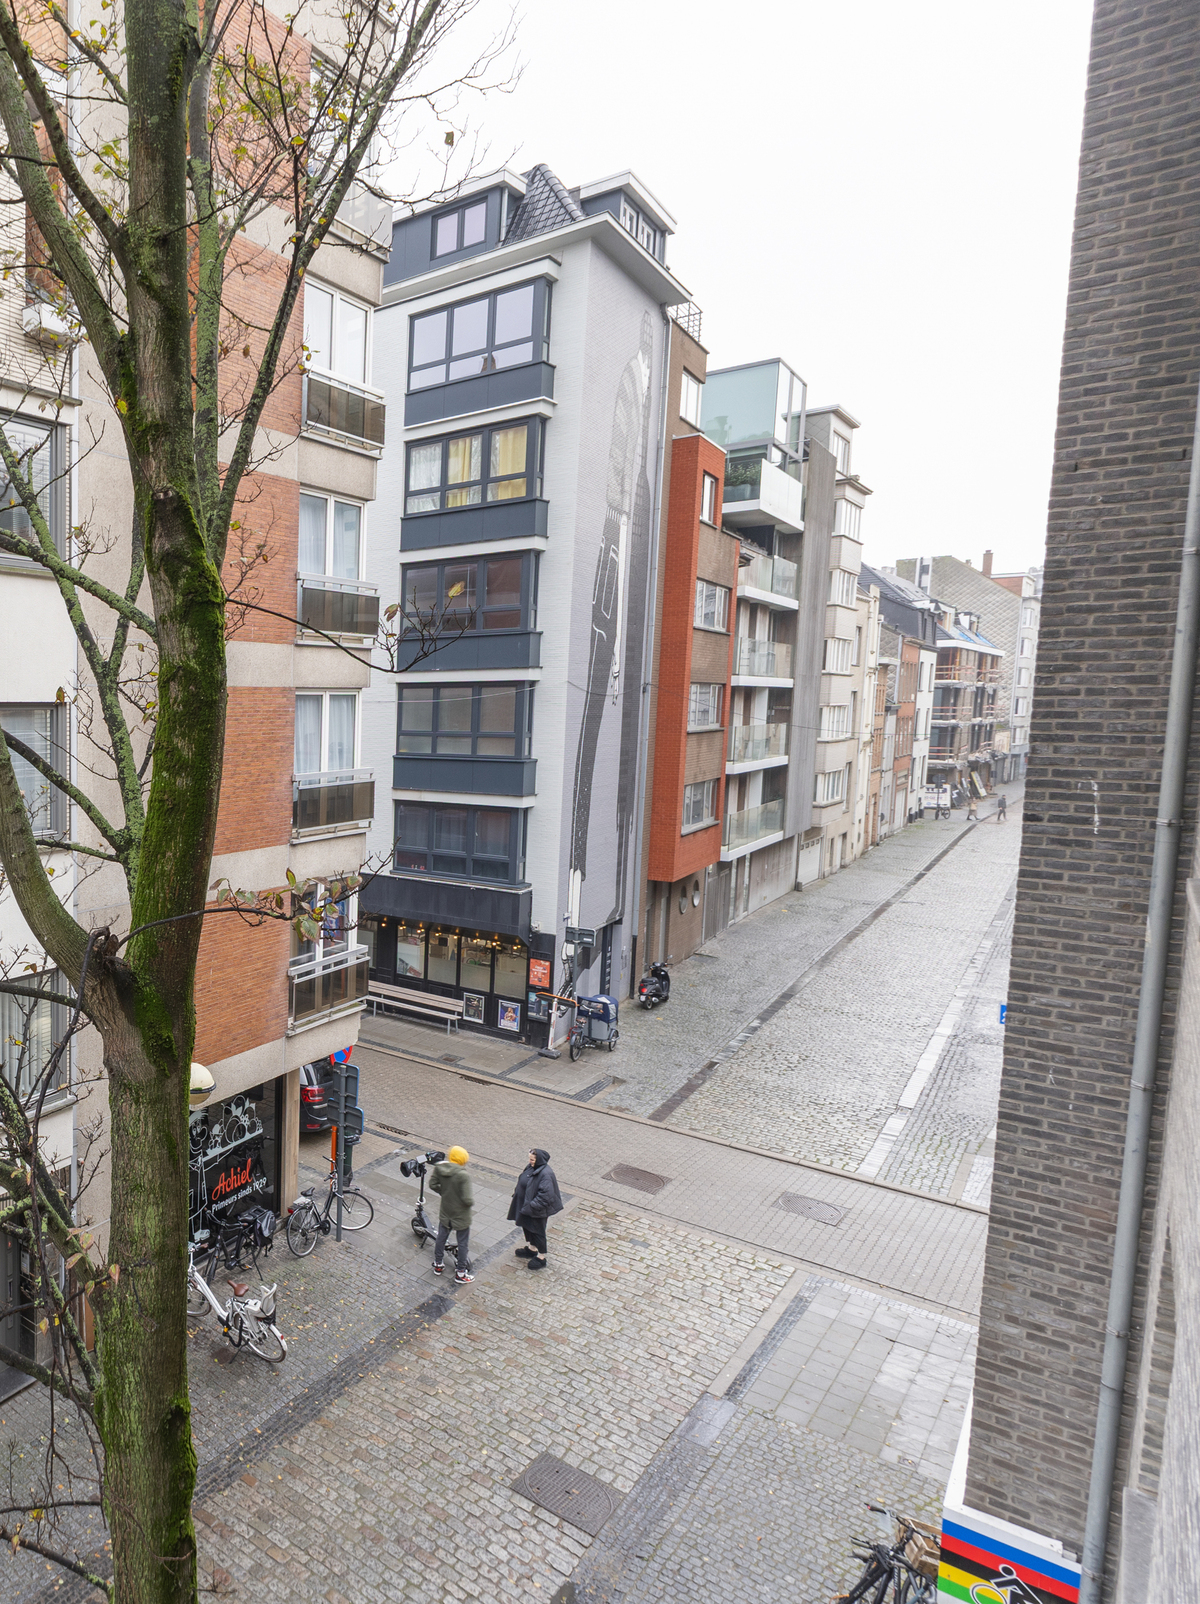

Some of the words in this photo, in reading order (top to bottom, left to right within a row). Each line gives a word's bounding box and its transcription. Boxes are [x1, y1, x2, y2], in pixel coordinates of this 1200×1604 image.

[212, 1158, 252, 1200] Achiel
[212, 1194, 237, 1214] Primeurs
[238, 1186, 252, 1199] sinds
[253, 1177, 267, 1191] 1929
